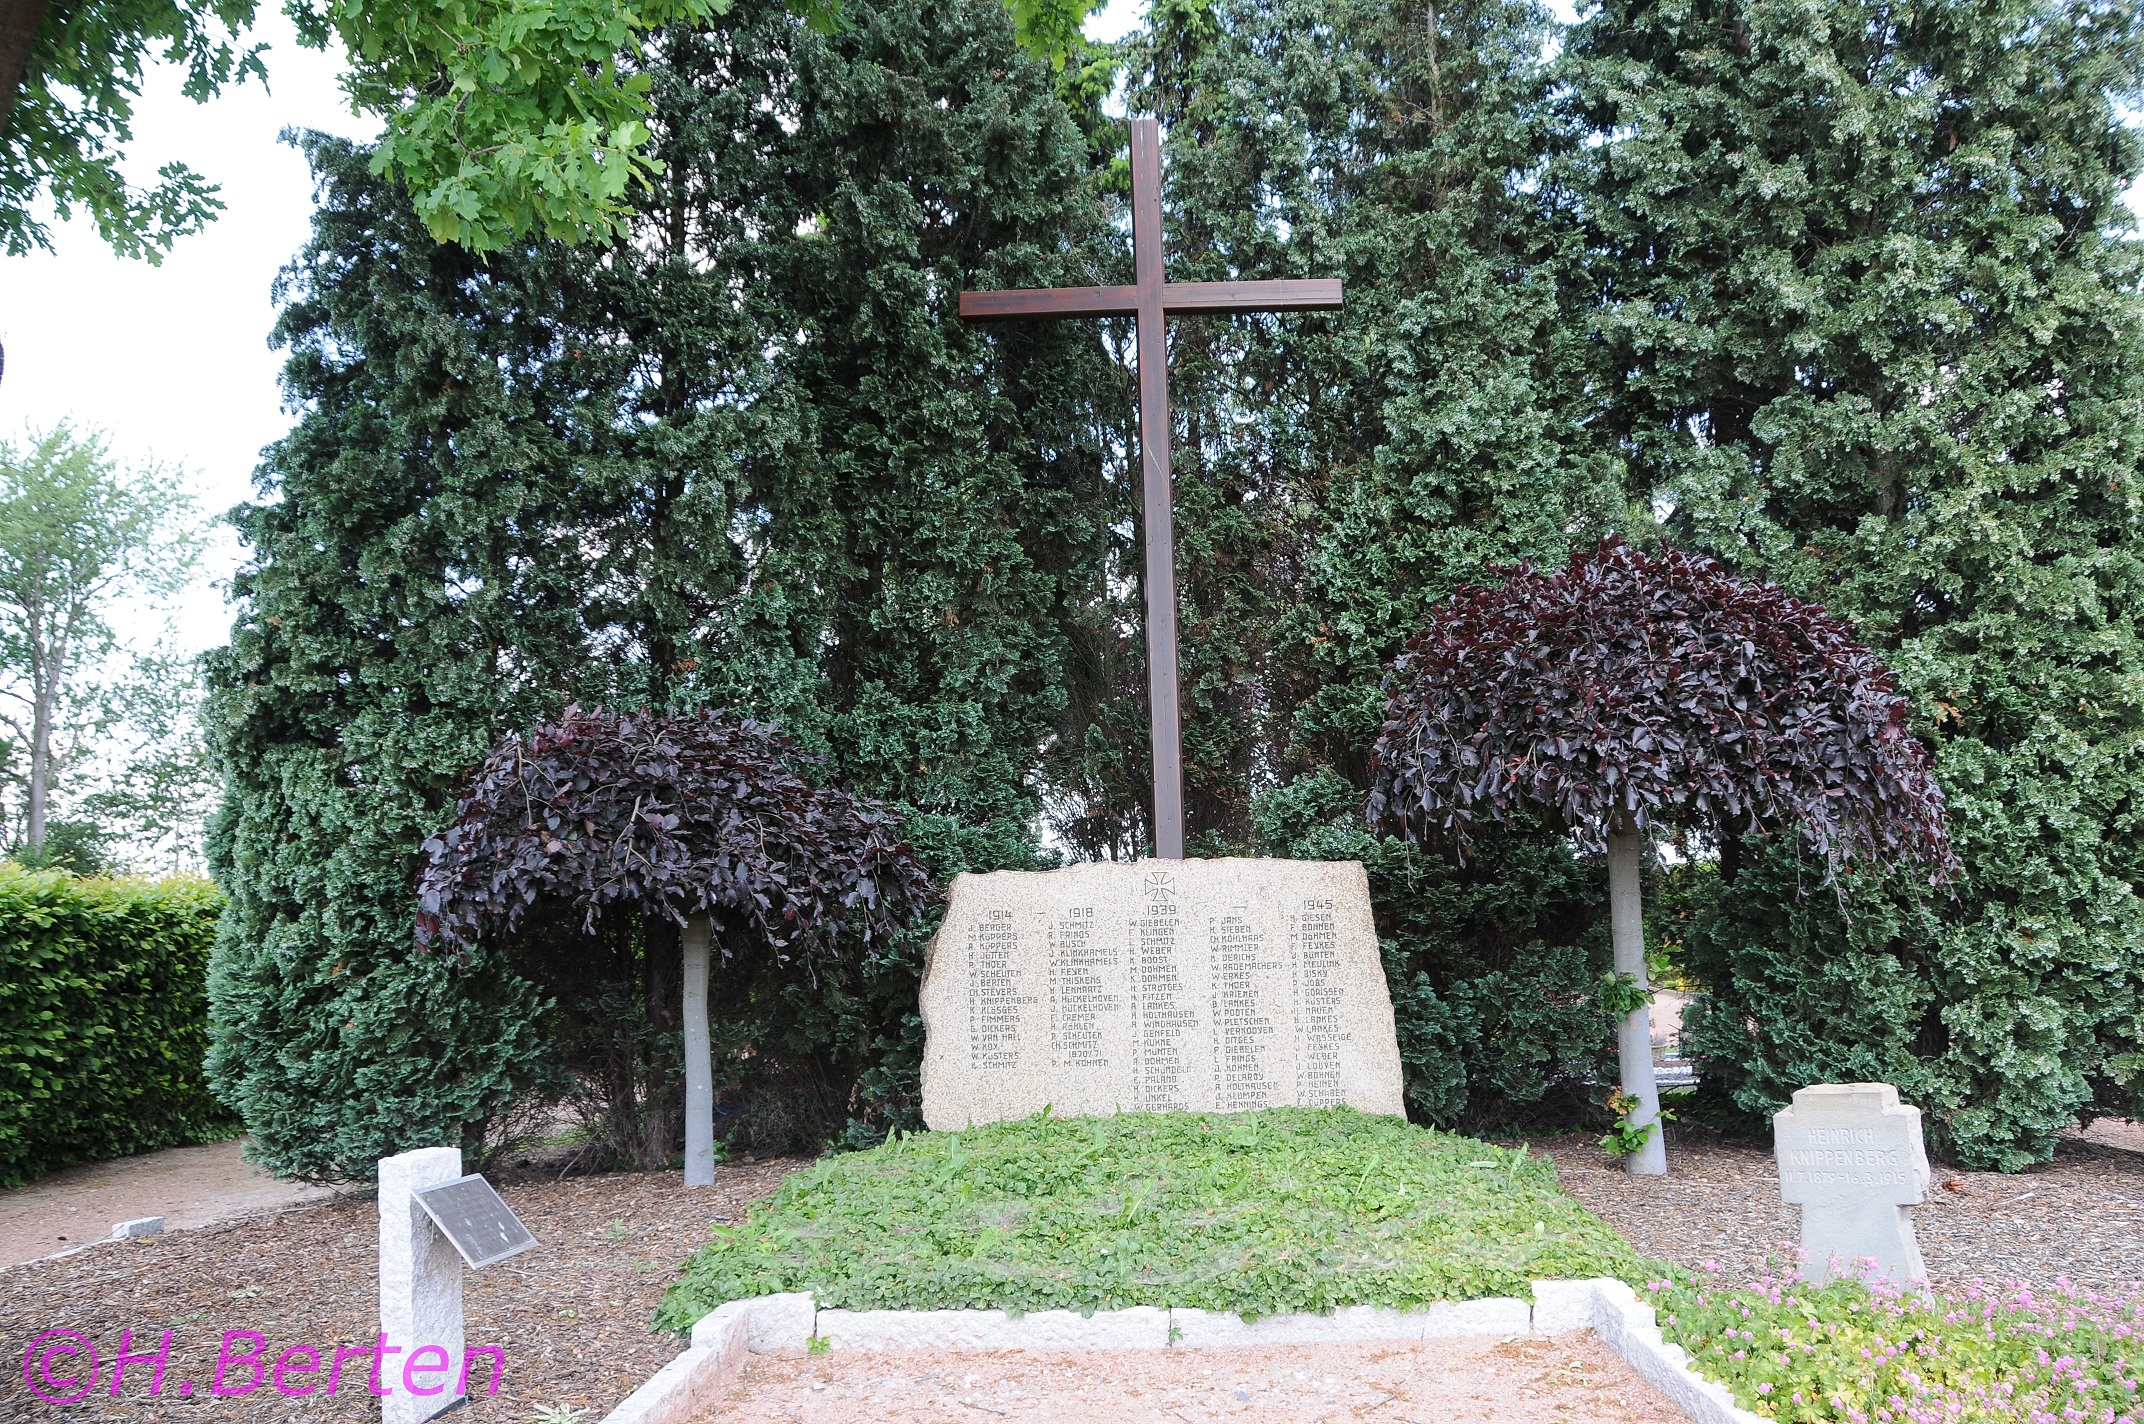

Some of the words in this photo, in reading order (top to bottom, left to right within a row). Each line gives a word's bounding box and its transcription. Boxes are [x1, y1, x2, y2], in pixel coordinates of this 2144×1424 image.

[1148, 904, 1176, 916] 1939
[1304, 900, 1332, 910] 1945
[989, 910, 1012, 920] 1914
[1069, 908, 1092, 918] 1918
[1060, 922, 1094, 930] SCHMITZ
[1222, 925, 1250, 934] SIEBEN
[1222, 962, 1282, 970] RADEMACHERS
[1062, 986, 1102, 994] LENNARTZ
[981, 996, 1038, 1004] KNIPPENBERG
[1062, 995, 1118, 1003] HÜCKELHOVEN
[1142, 1002, 1174, 1010] LANKES
[1144, 1010, 1194, 1018] HOLTHAUSEN
[1306, 1015, 1338, 1023] LANKES
[1144, 1020, 1198, 1028] WINDHAUSEN
[1307, 1025, 1338, 1033] LANKES
[1226, 1036, 1254, 1044] DITGES
[1307, 1033, 1352, 1041] WASSEIGE
[1063, 1041, 1098, 1049] SCHMITZ
[1145, 1057, 1180, 1065] DOHMEN
[1308, 1062, 1340, 1070] LOUVEN
[1228, 1092, 1266, 1100] KLUMPEN
[1228, 1100, 1268, 1108] HENNINGS
[1808, 1128, 1874, 1145] HEINRICH
[1790, 1149, 1900, 1166] KNIPPENBERG
